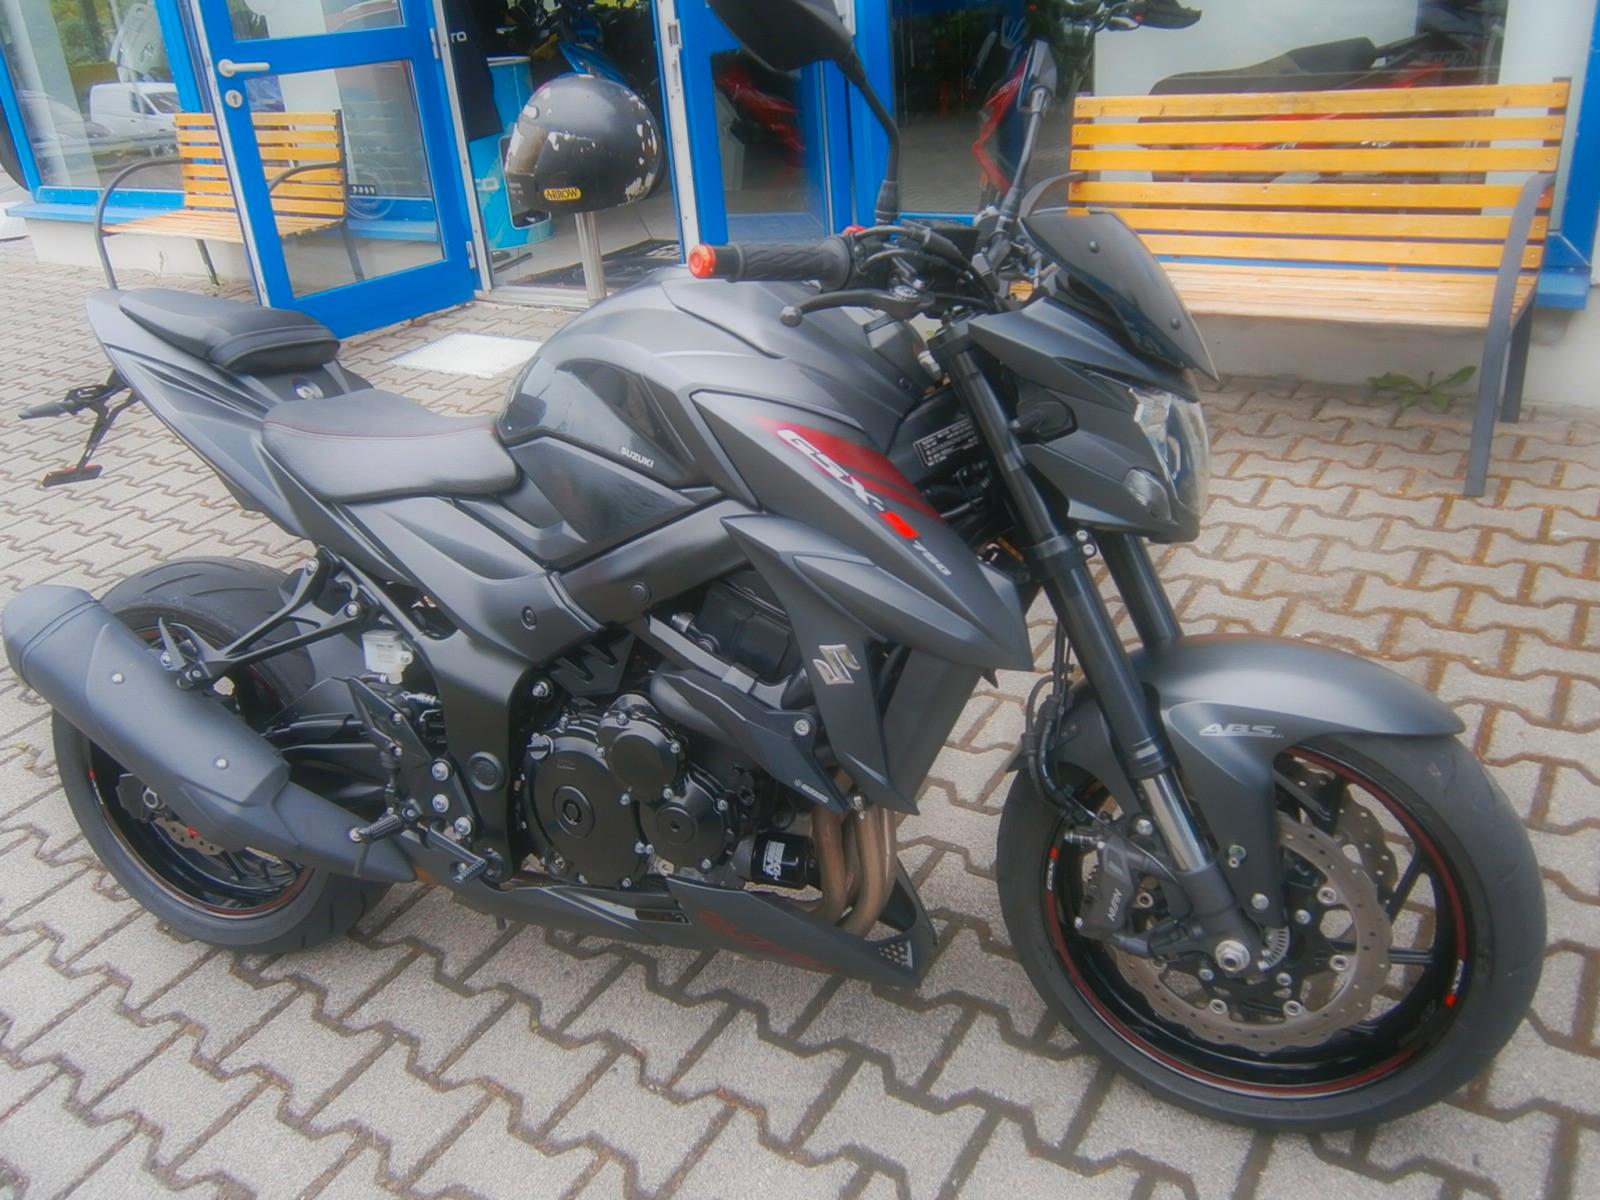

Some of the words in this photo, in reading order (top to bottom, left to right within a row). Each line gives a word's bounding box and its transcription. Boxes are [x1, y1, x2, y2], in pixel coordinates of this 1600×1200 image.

[545, 188, 580, 199] ARROW
[620, 446, 655, 469] SUZUKI
[1199, 723, 1277, 737] ABS
